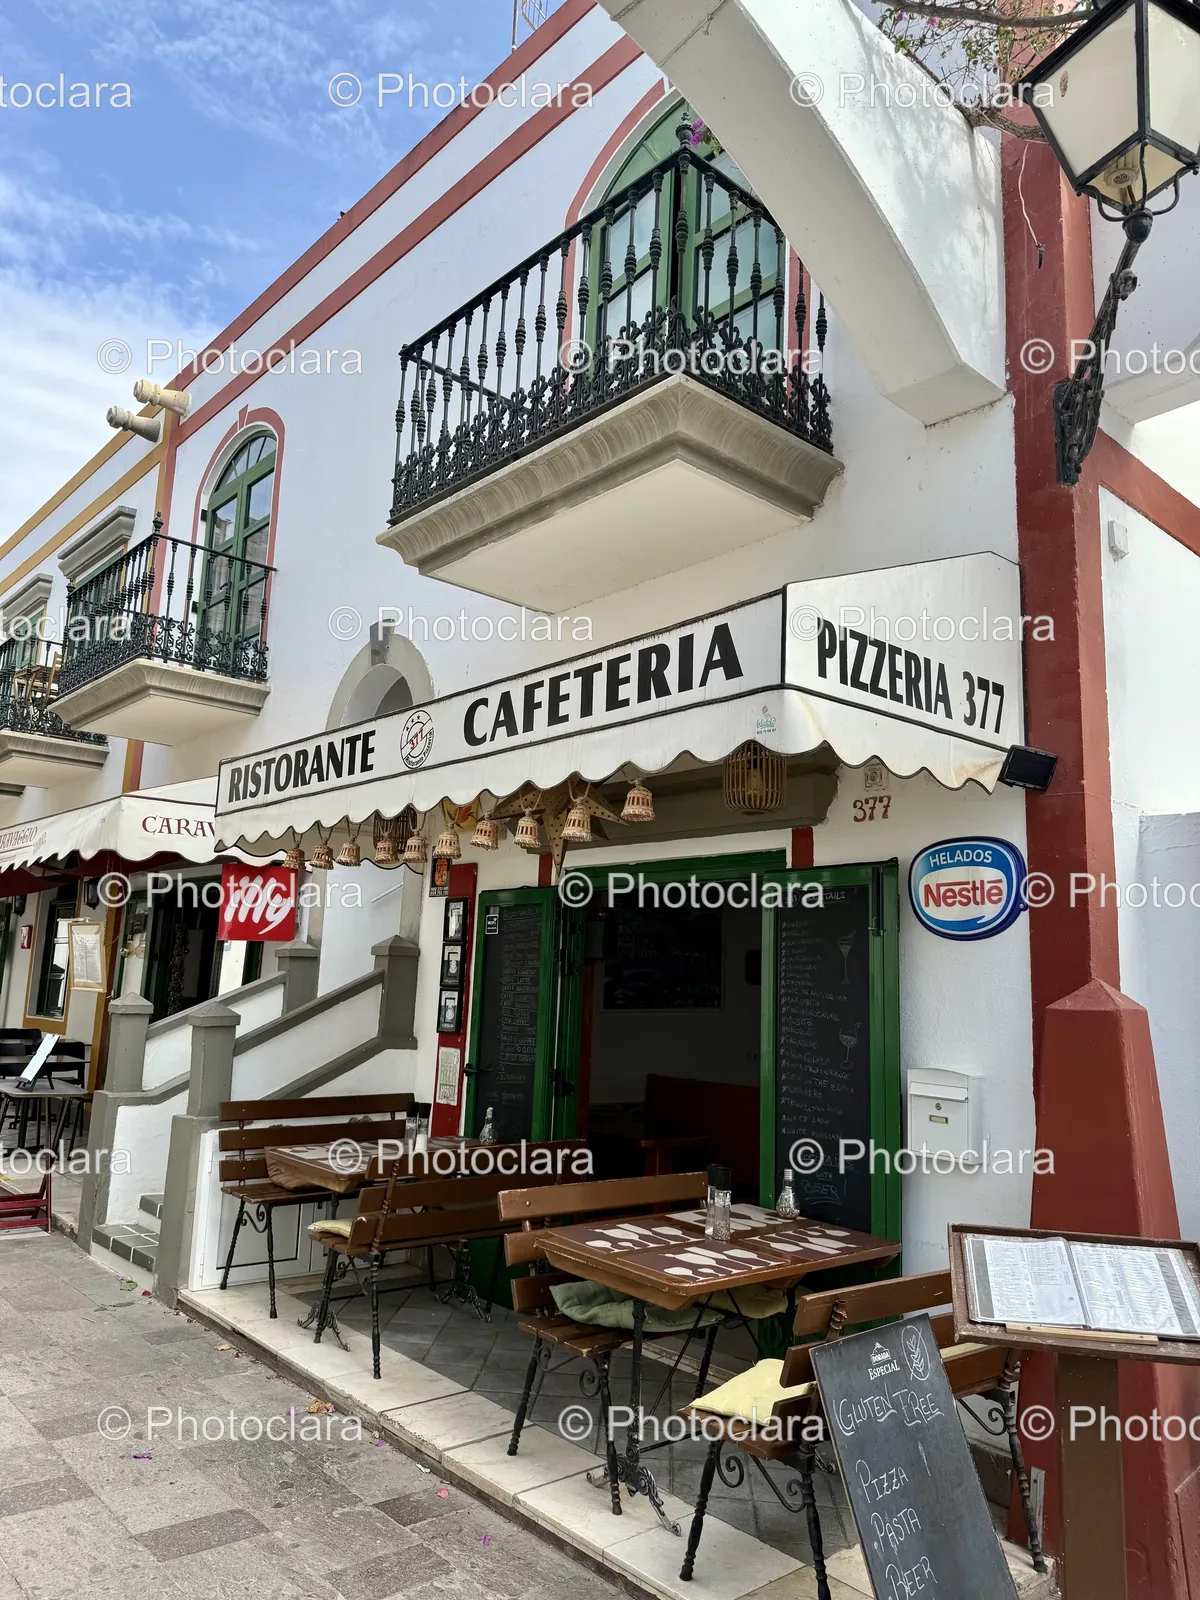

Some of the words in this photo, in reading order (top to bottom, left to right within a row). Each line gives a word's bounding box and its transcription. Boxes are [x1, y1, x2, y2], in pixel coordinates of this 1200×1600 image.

[817, 620, 953, 720] PIZZERIA
[962, 671, 1005, 734] 377
[229, 730, 376, 803] RISTORANTE
[464, 622, 743, 746] CAFETERIA
[853, 795, 891, 822] 377
[929, 849, 993, 868] HELADOS
[224, 874, 292, 935] illy
[924, 879, 1003, 908] Nestlé
[868, 1359, 900, 1380] ESPECIAL
[833, 1386, 897, 1436] GLUTEN
[893, 1388, 944, 1426] FREE
[856, 1459, 909, 1503] PIZZA
[870, 1507, 922, 1552] PASTA
[885, 1556, 938, 1600] BEER
